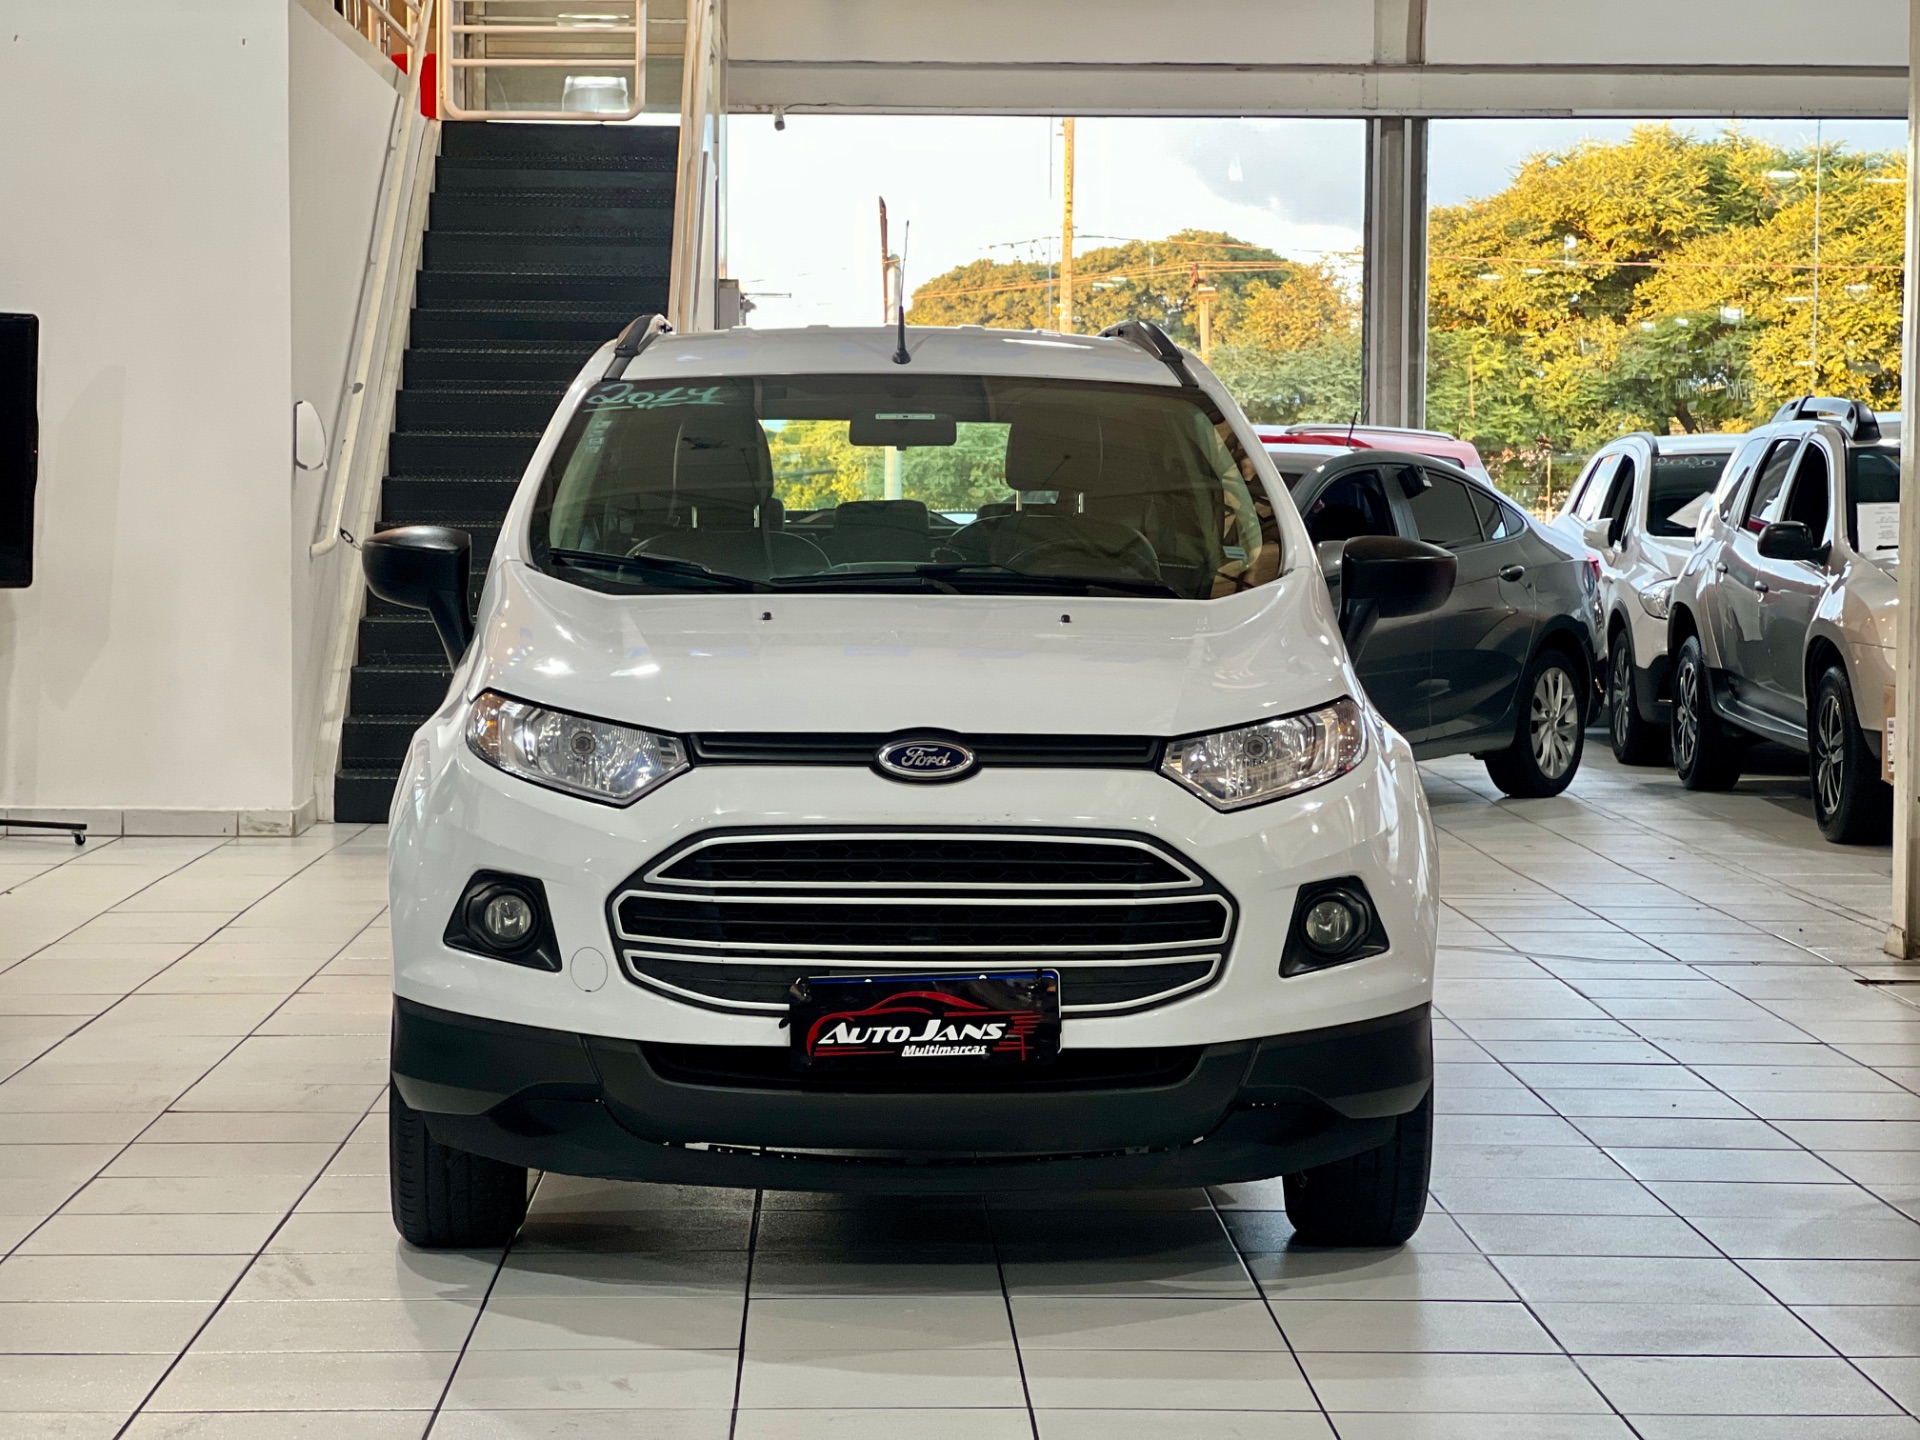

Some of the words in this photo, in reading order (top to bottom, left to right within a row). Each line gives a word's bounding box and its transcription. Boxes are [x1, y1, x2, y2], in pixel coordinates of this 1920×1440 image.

[585, 382, 721, 406] 2014
[901, 746, 950, 766] Ford
[901, 1044, 987, 1056] Multimarcas
